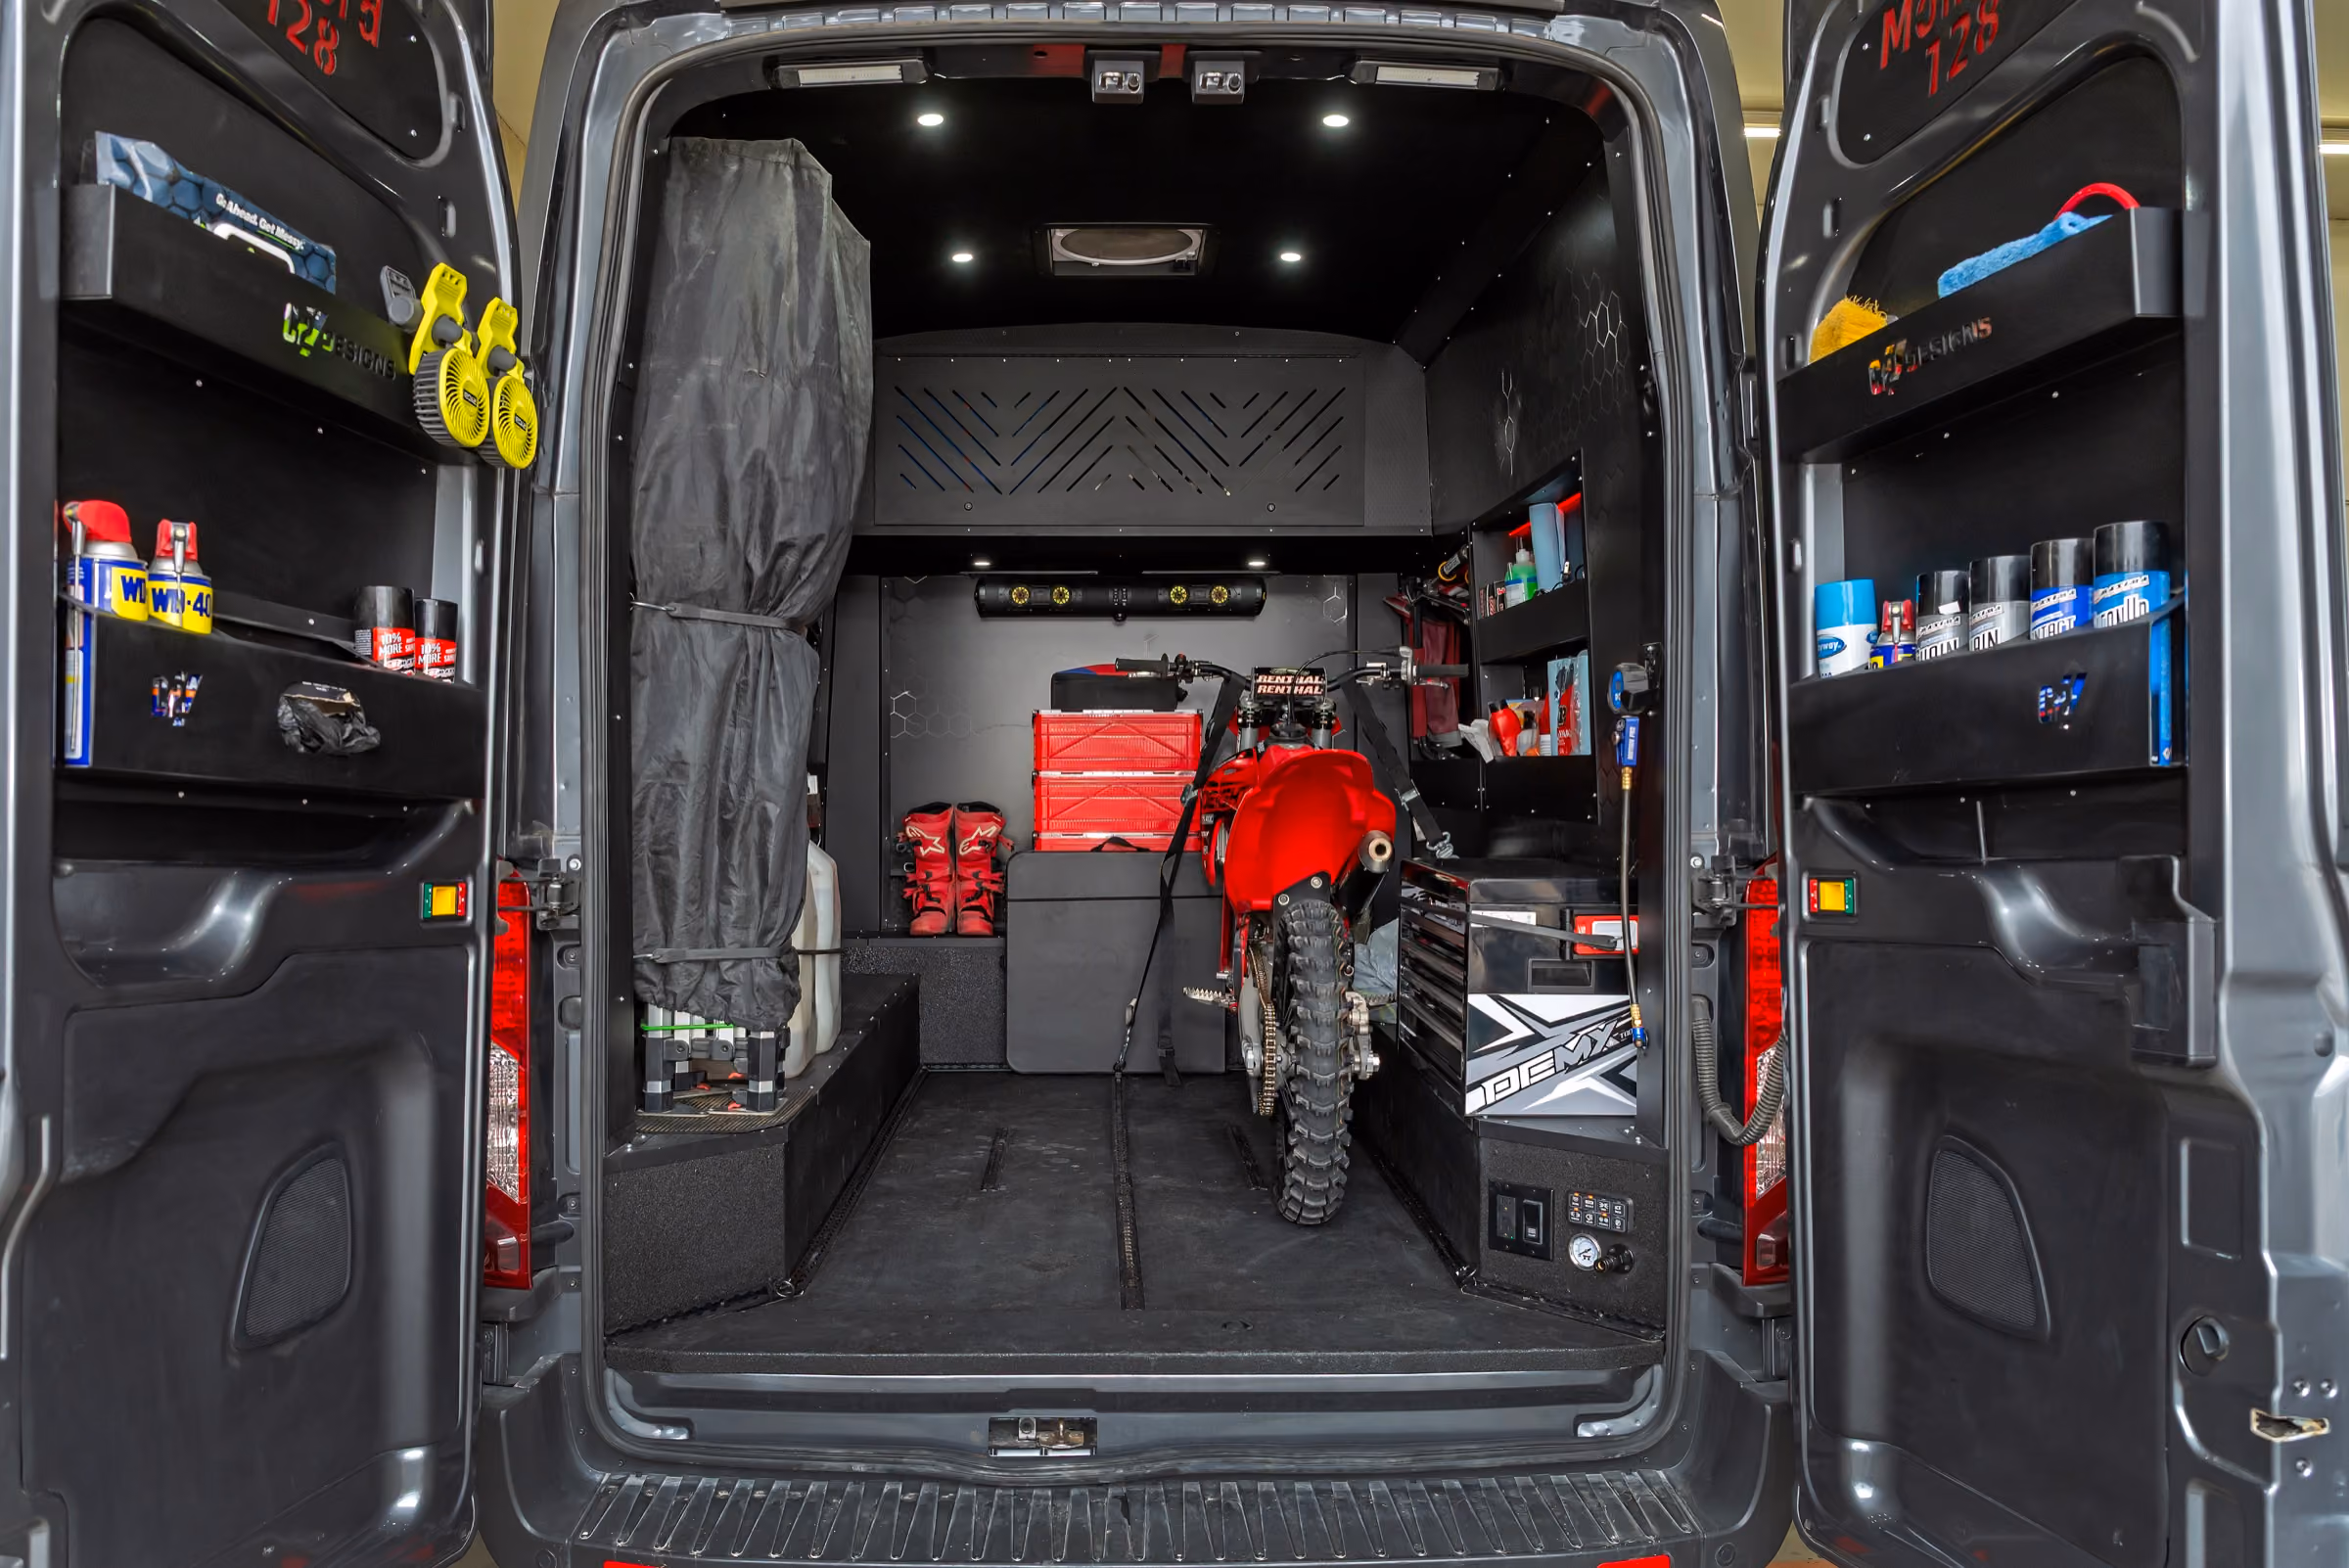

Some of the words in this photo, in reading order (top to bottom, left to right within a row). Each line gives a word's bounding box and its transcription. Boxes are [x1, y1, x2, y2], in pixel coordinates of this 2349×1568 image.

[1925, 0, 1999, 97] 128
[258, 216, 276, 235] Get
[152, 587, 211, 618] WD-40
[382, 632, 402, 646] 10%
[379, 642, 403, 657] MORE
[418, 653, 442, 666] MORE
[1257, 674, 1323, 684] RENTHAL
[1257, 684, 1323, 695] RENTHAL
